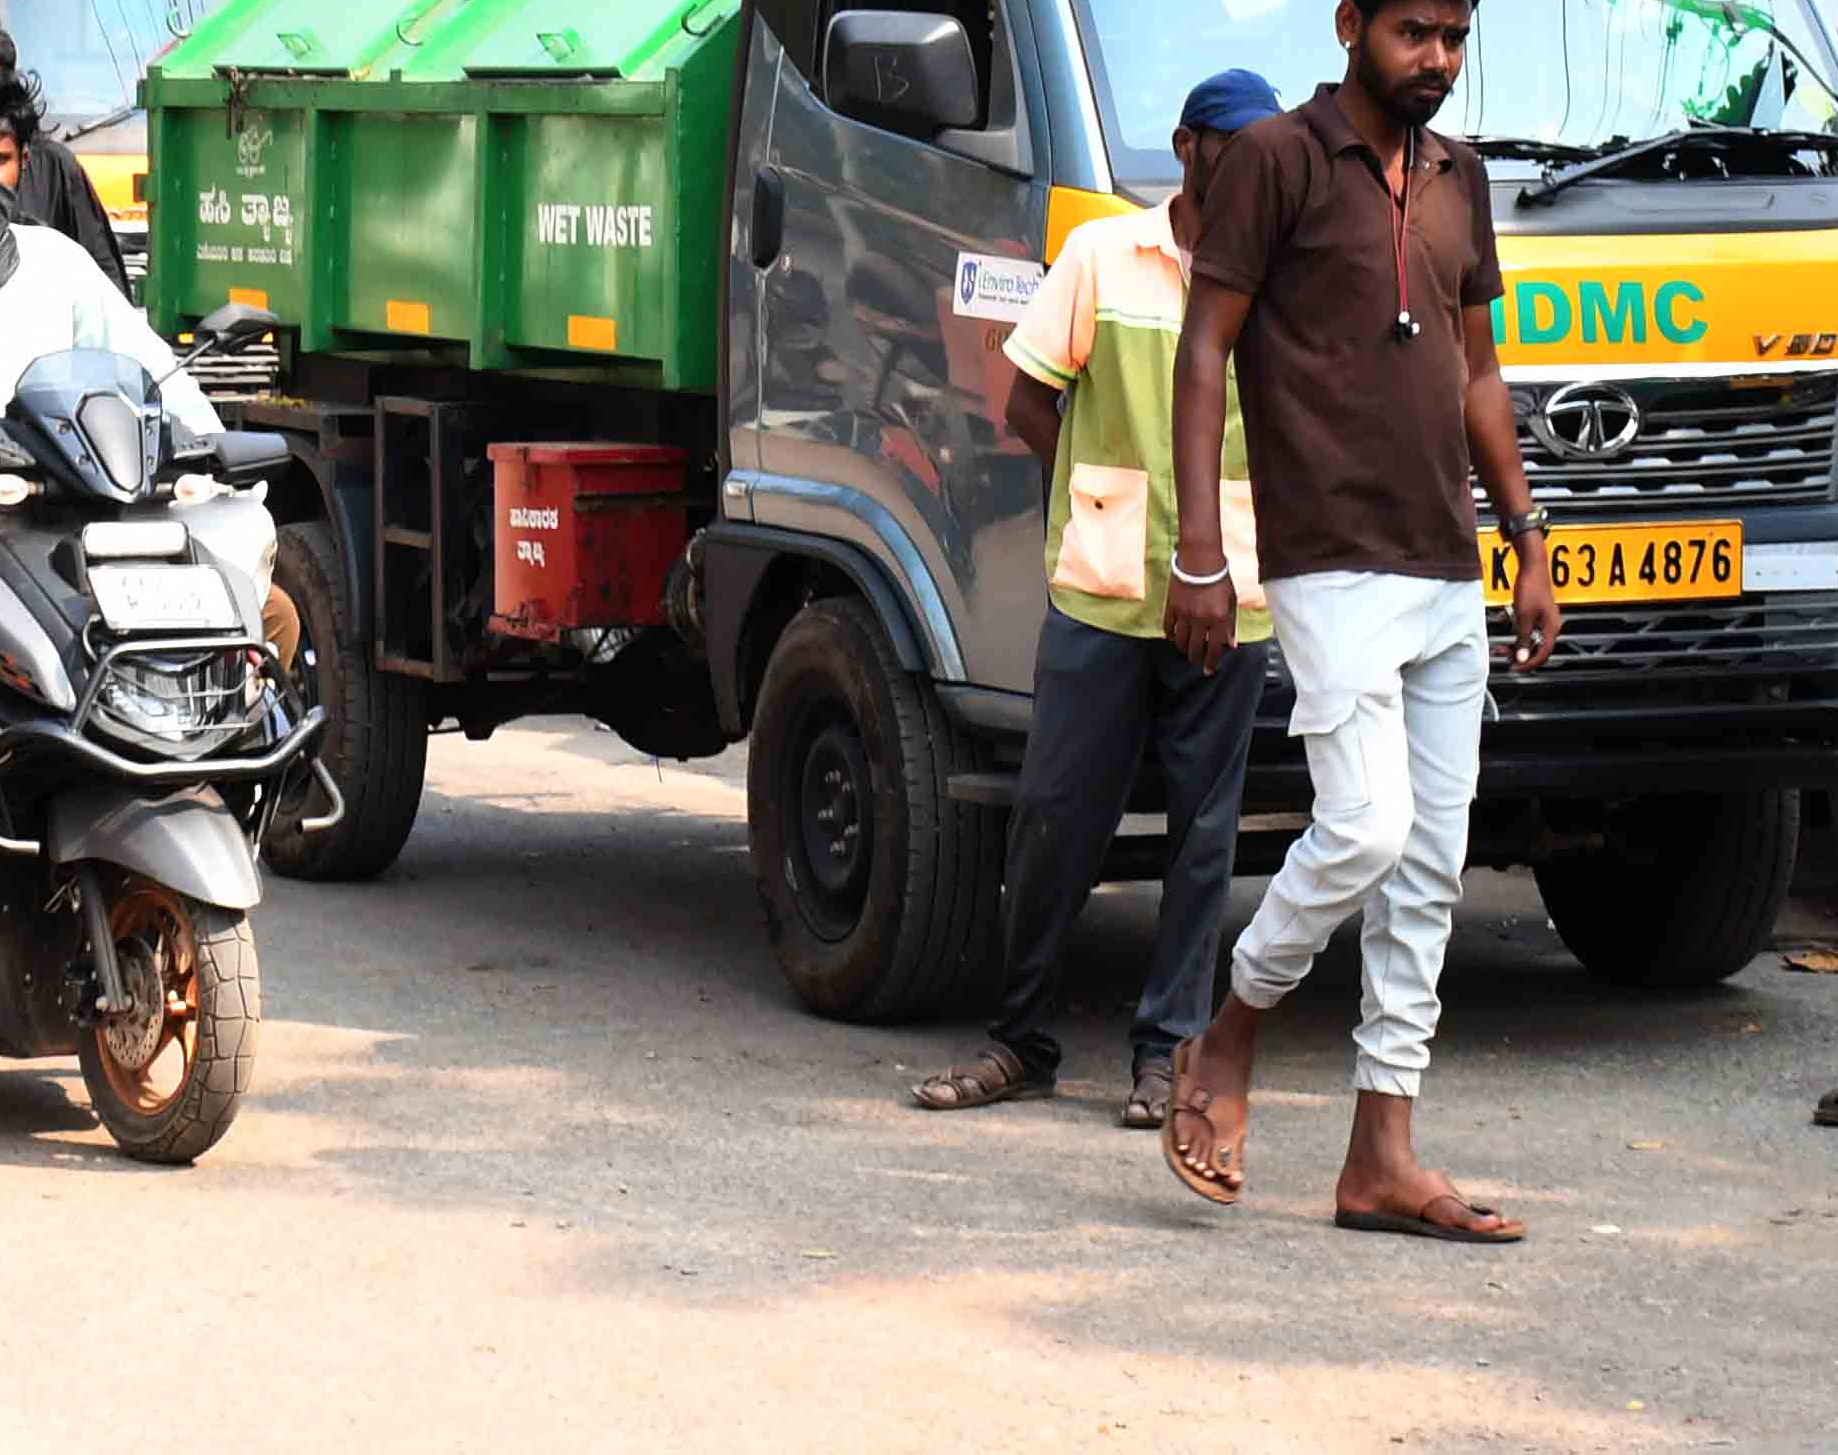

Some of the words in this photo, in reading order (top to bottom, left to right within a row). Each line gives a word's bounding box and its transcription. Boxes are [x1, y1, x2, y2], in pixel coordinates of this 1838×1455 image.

[199, 183, 231, 224] ಹಸಿ
[538, 203, 581, 244] WET
[585, 205, 652, 247] WASTE
